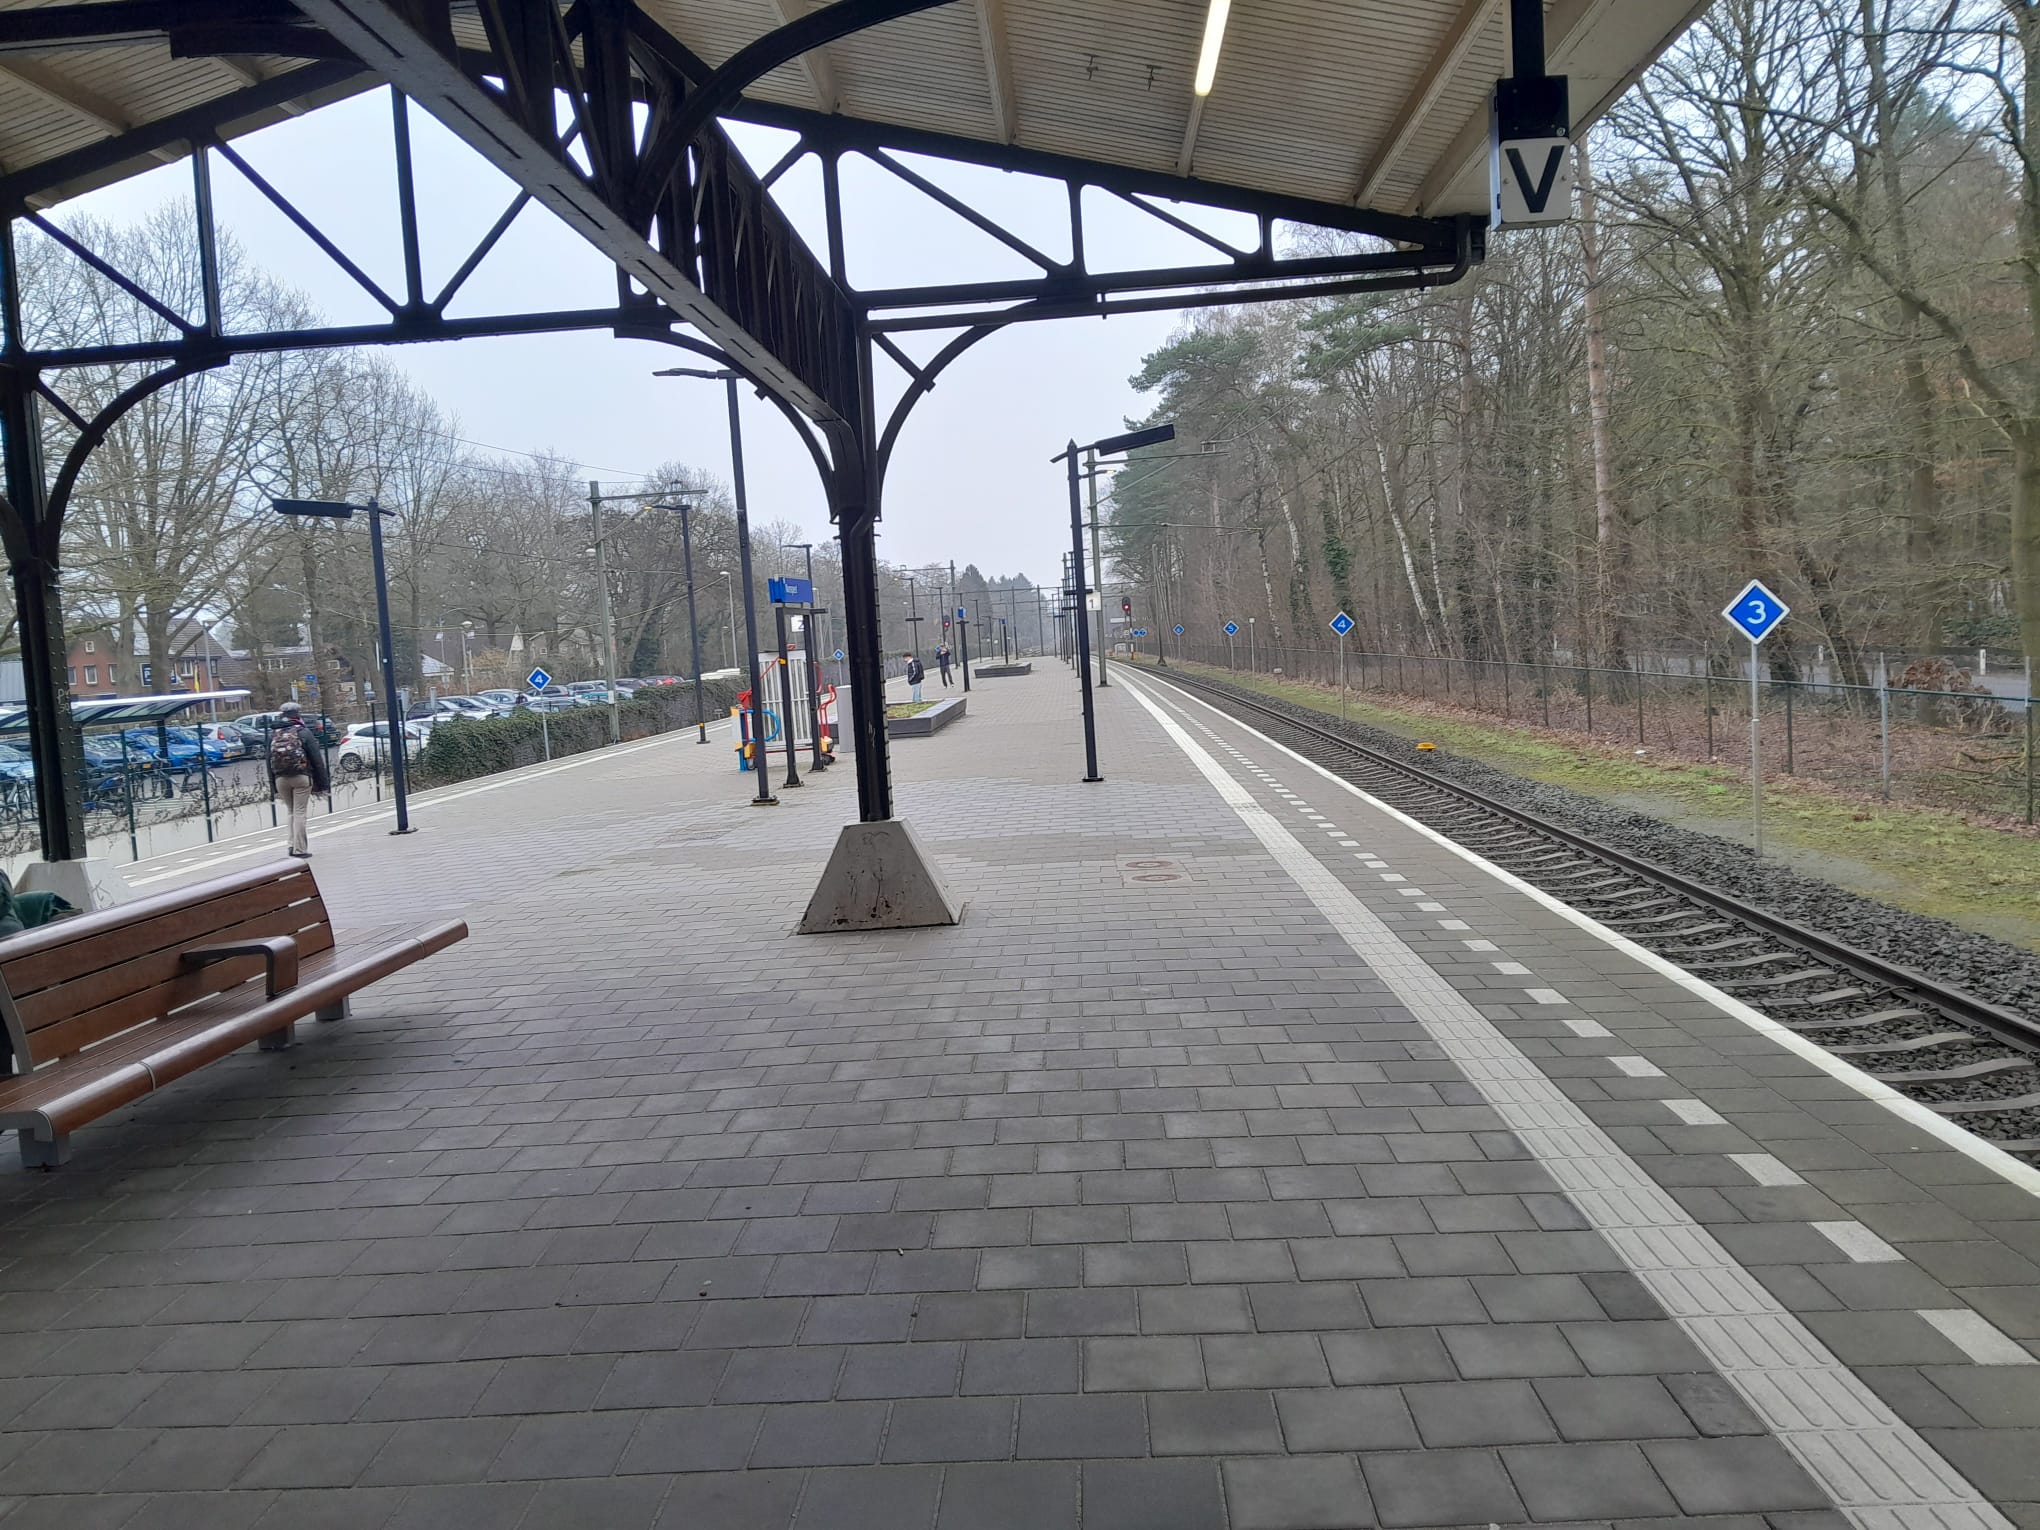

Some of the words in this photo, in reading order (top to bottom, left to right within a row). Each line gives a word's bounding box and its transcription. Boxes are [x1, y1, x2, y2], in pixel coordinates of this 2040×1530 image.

[1505, 145, 1565, 213] V
[1088, 600, 1093, 608] 1
[1747, 600, 1767, 625] 3
[1337, 619, 1346, 628] 4
[534, 674, 544, 684] 4
